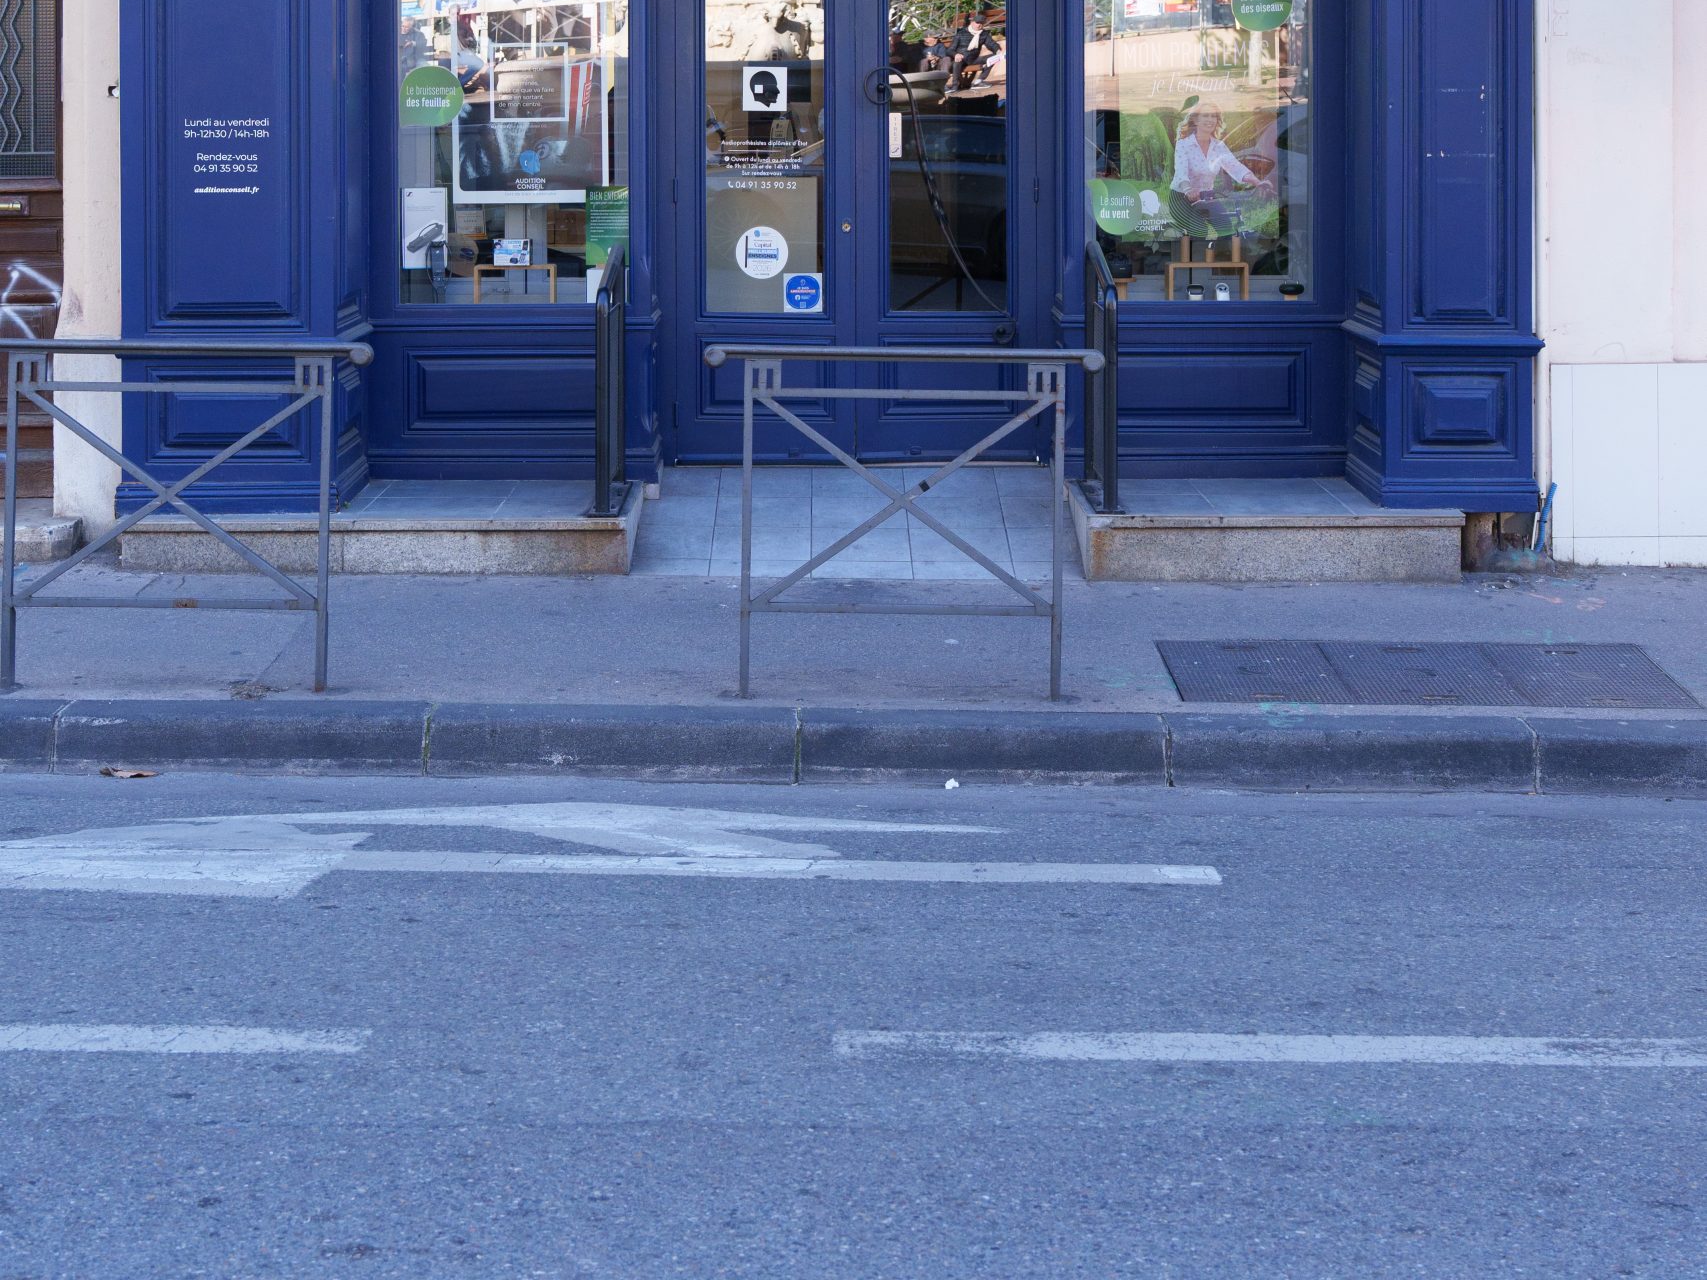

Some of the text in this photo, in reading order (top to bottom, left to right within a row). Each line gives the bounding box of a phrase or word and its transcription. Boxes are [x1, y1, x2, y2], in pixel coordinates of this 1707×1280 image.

[1240, 2, 1284, 13] des oiseaux
[1123, 39, 1270, 68] MON PRINTEMS
[1151, 74, 1165, 97] je
[1168, 71, 1235, 93] l'entends
[406, 84, 456, 96] Le bruissement
[406, 97, 450, 107] des feuilles
[184, 118, 212, 127] Lundi
[227, 118, 270, 127] vendredi
[184, 129, 227, 138] 9h-12h30
[234, 129, 270, 138] 14h-18h
[196, 152, 258, 161] Rendez-vous
[194, 164, 258, 173] 04 91 35 90 52
[735, 181, 797, 189] 04 91 35 90 52
[194, 186, 260, 195] auditionconseil.fr
[590, 191, 603, 200] BIEN
[1100, 195, 1135, 206] Le souffle
[1100, 208, 1130, 219] du vent
